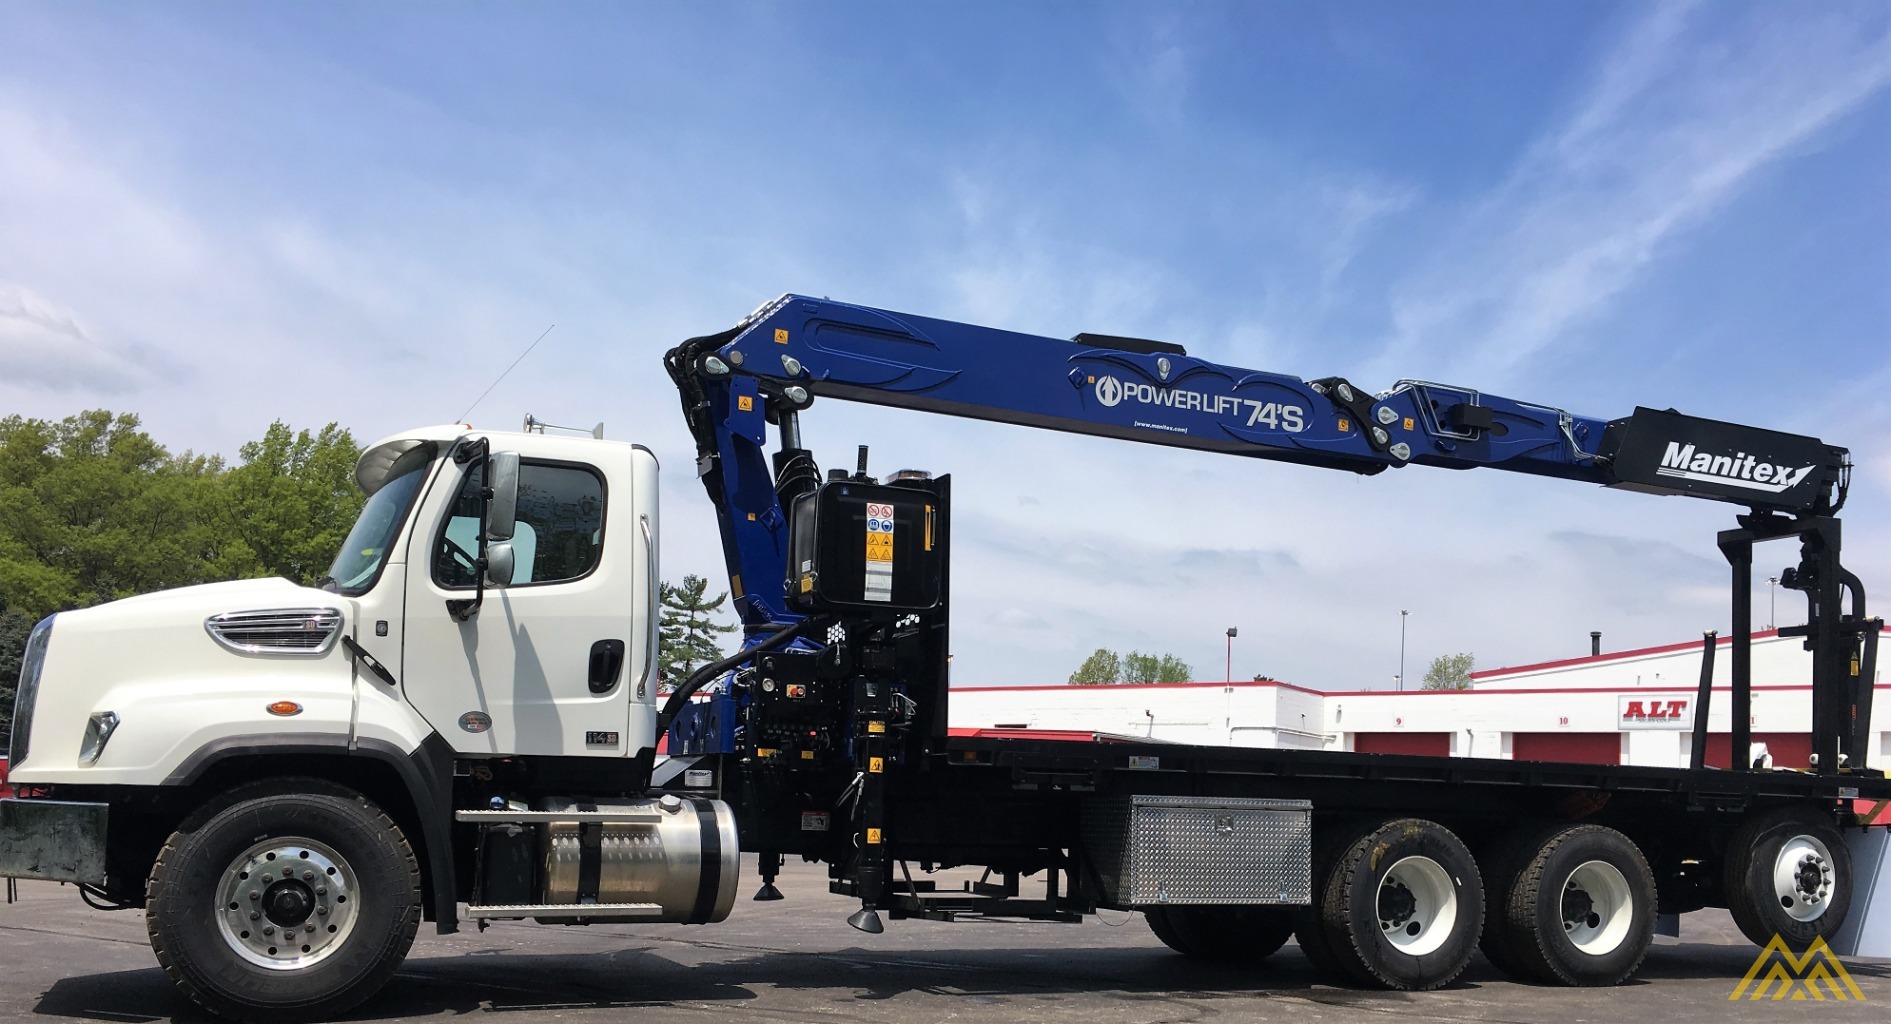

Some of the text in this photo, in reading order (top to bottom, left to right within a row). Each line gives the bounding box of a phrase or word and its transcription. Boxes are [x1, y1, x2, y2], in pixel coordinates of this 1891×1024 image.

[1243, 400, 1304, 433] 74'S
[1660, 441, 1796, 487] Manitex
[1559, 717, 1569, 725] 10
[1623, 700, 1688, 719] ALT
